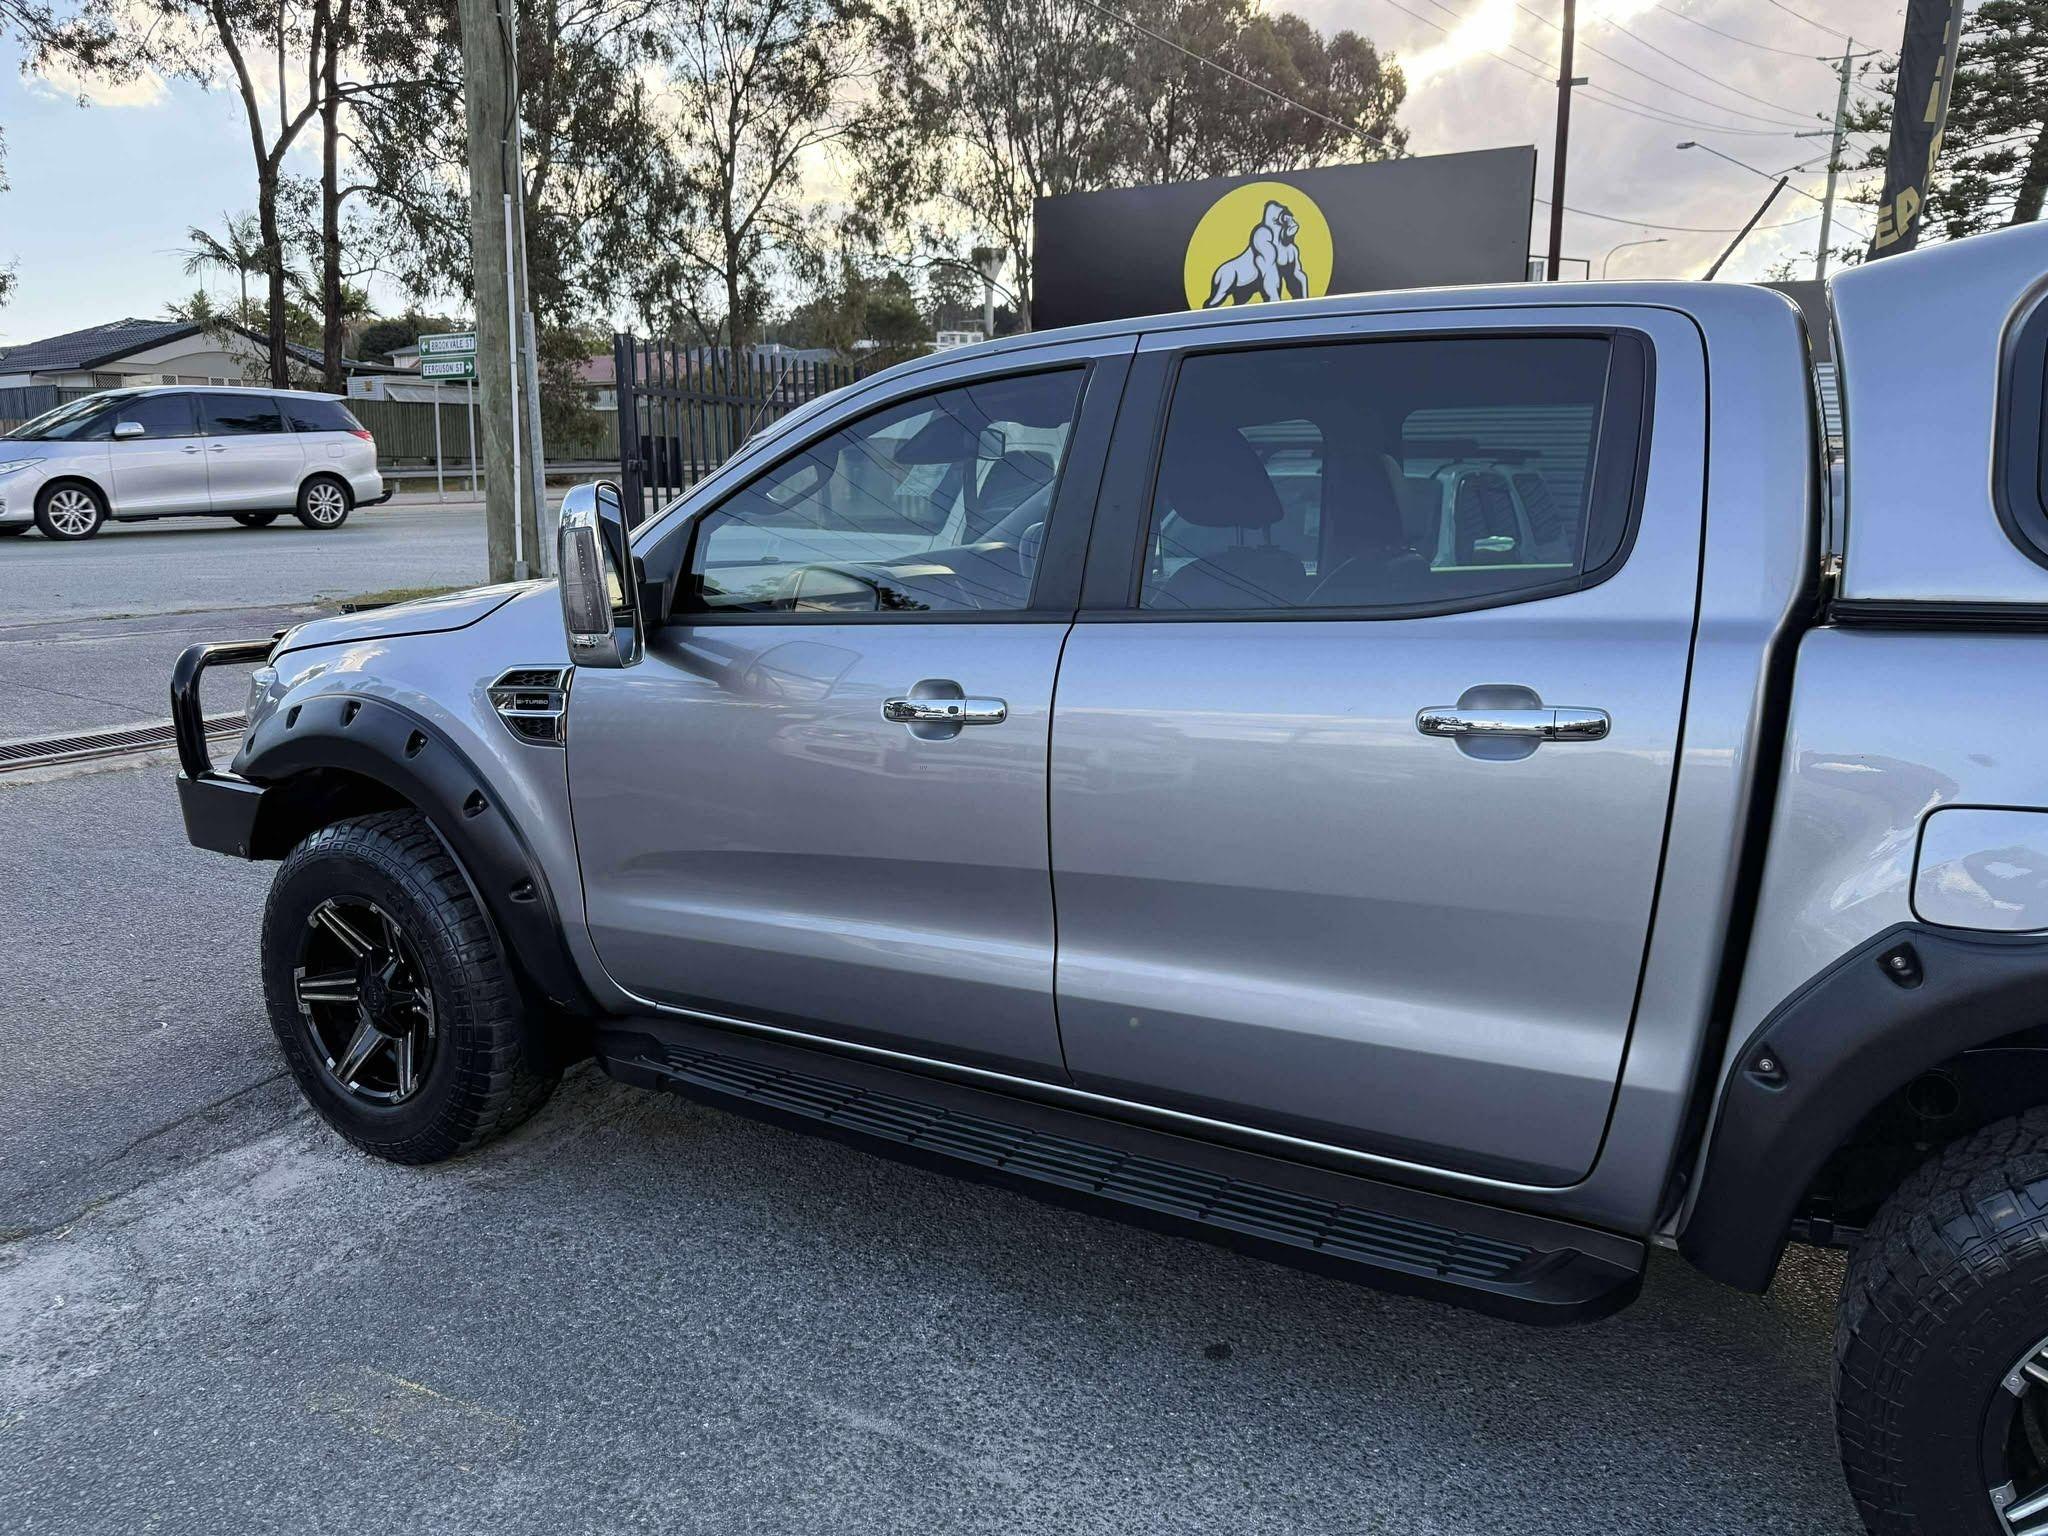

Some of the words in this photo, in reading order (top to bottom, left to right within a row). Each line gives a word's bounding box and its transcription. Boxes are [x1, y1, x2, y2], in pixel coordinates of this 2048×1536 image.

[430, 339, 464, 351] BROOKVALE
[465, 338, 474, 348] ST
[424, 364, 454, 374] FERGUSON
[456, 363, 463, 372] ST
